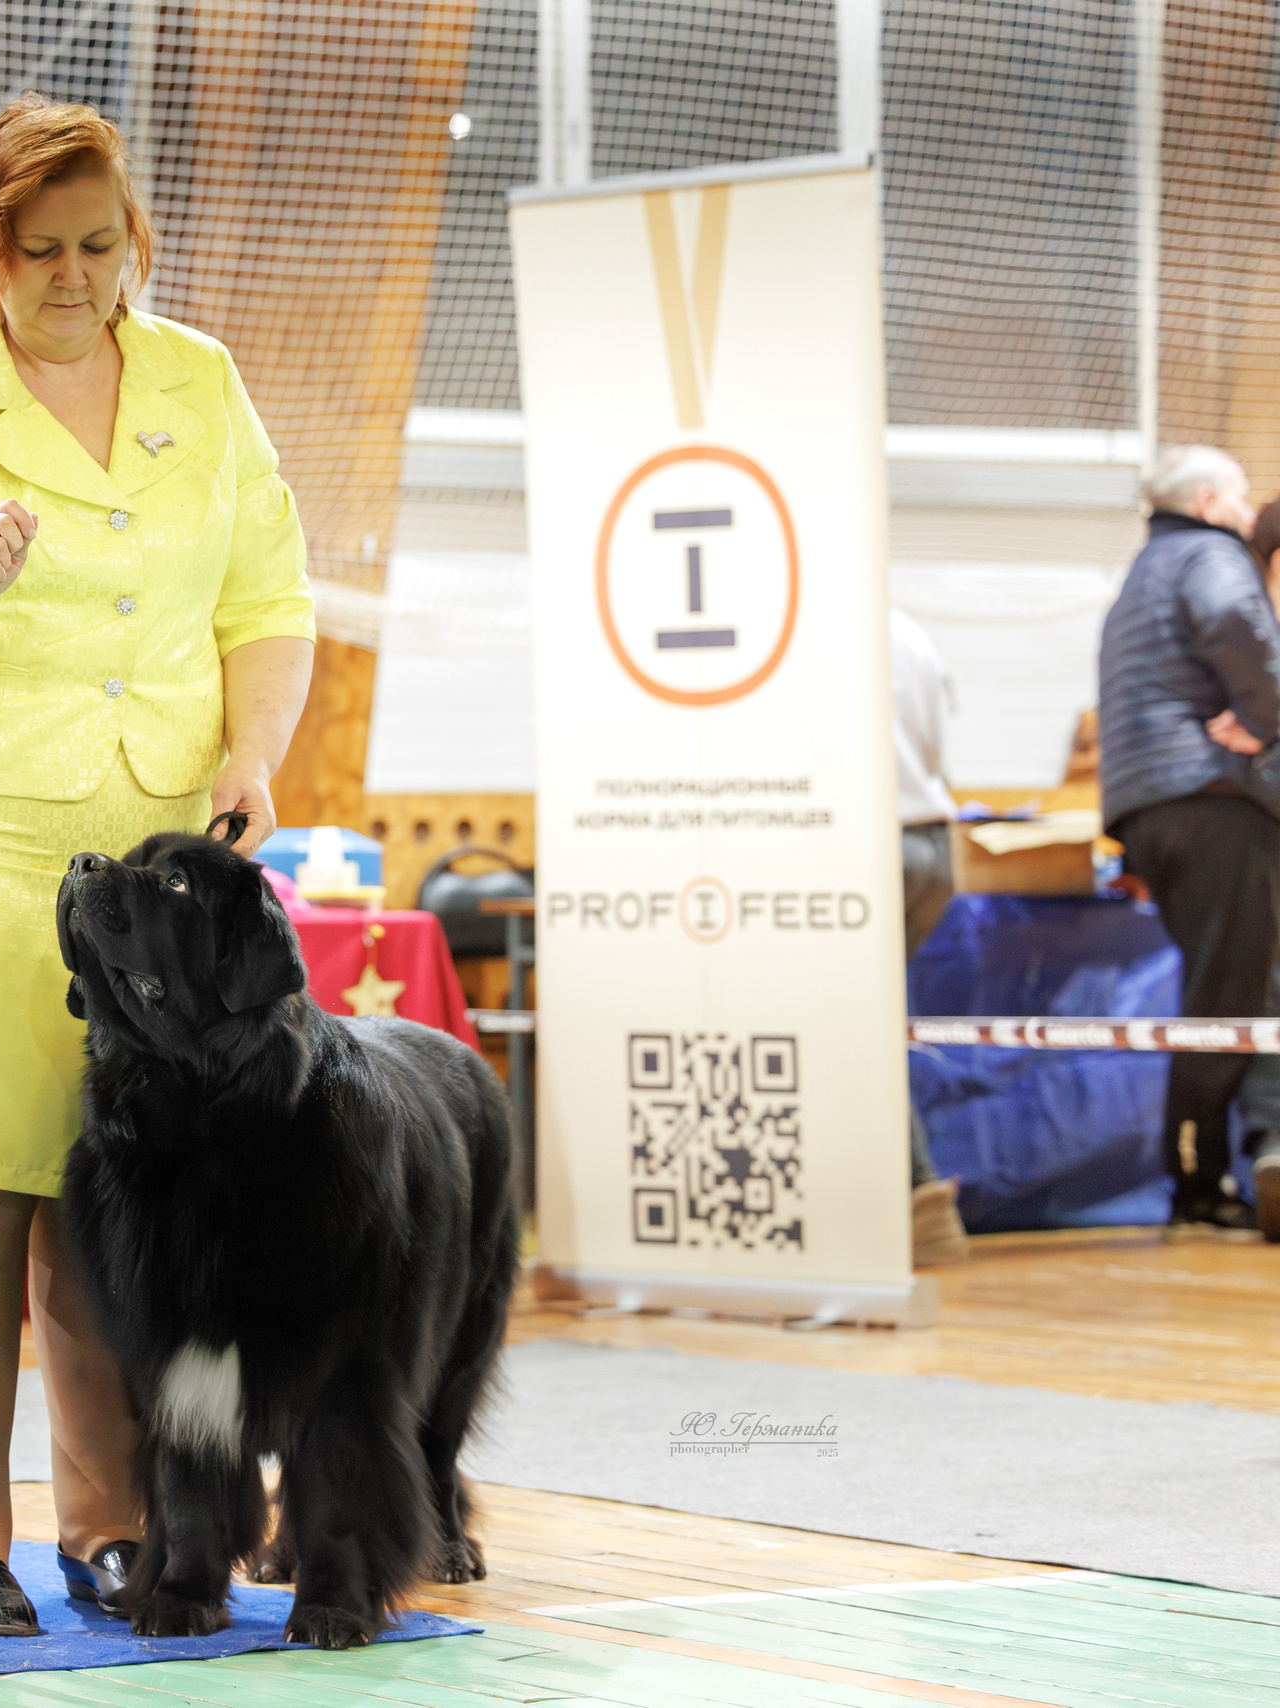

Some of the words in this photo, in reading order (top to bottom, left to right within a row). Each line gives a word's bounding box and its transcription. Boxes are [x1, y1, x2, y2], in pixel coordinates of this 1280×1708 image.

[575, 811, 651, 830] КОРМА
[657, 810, 705, 831] ДЛЯ
[711, 807, 835, 830] ПИТОМЦЕВ
